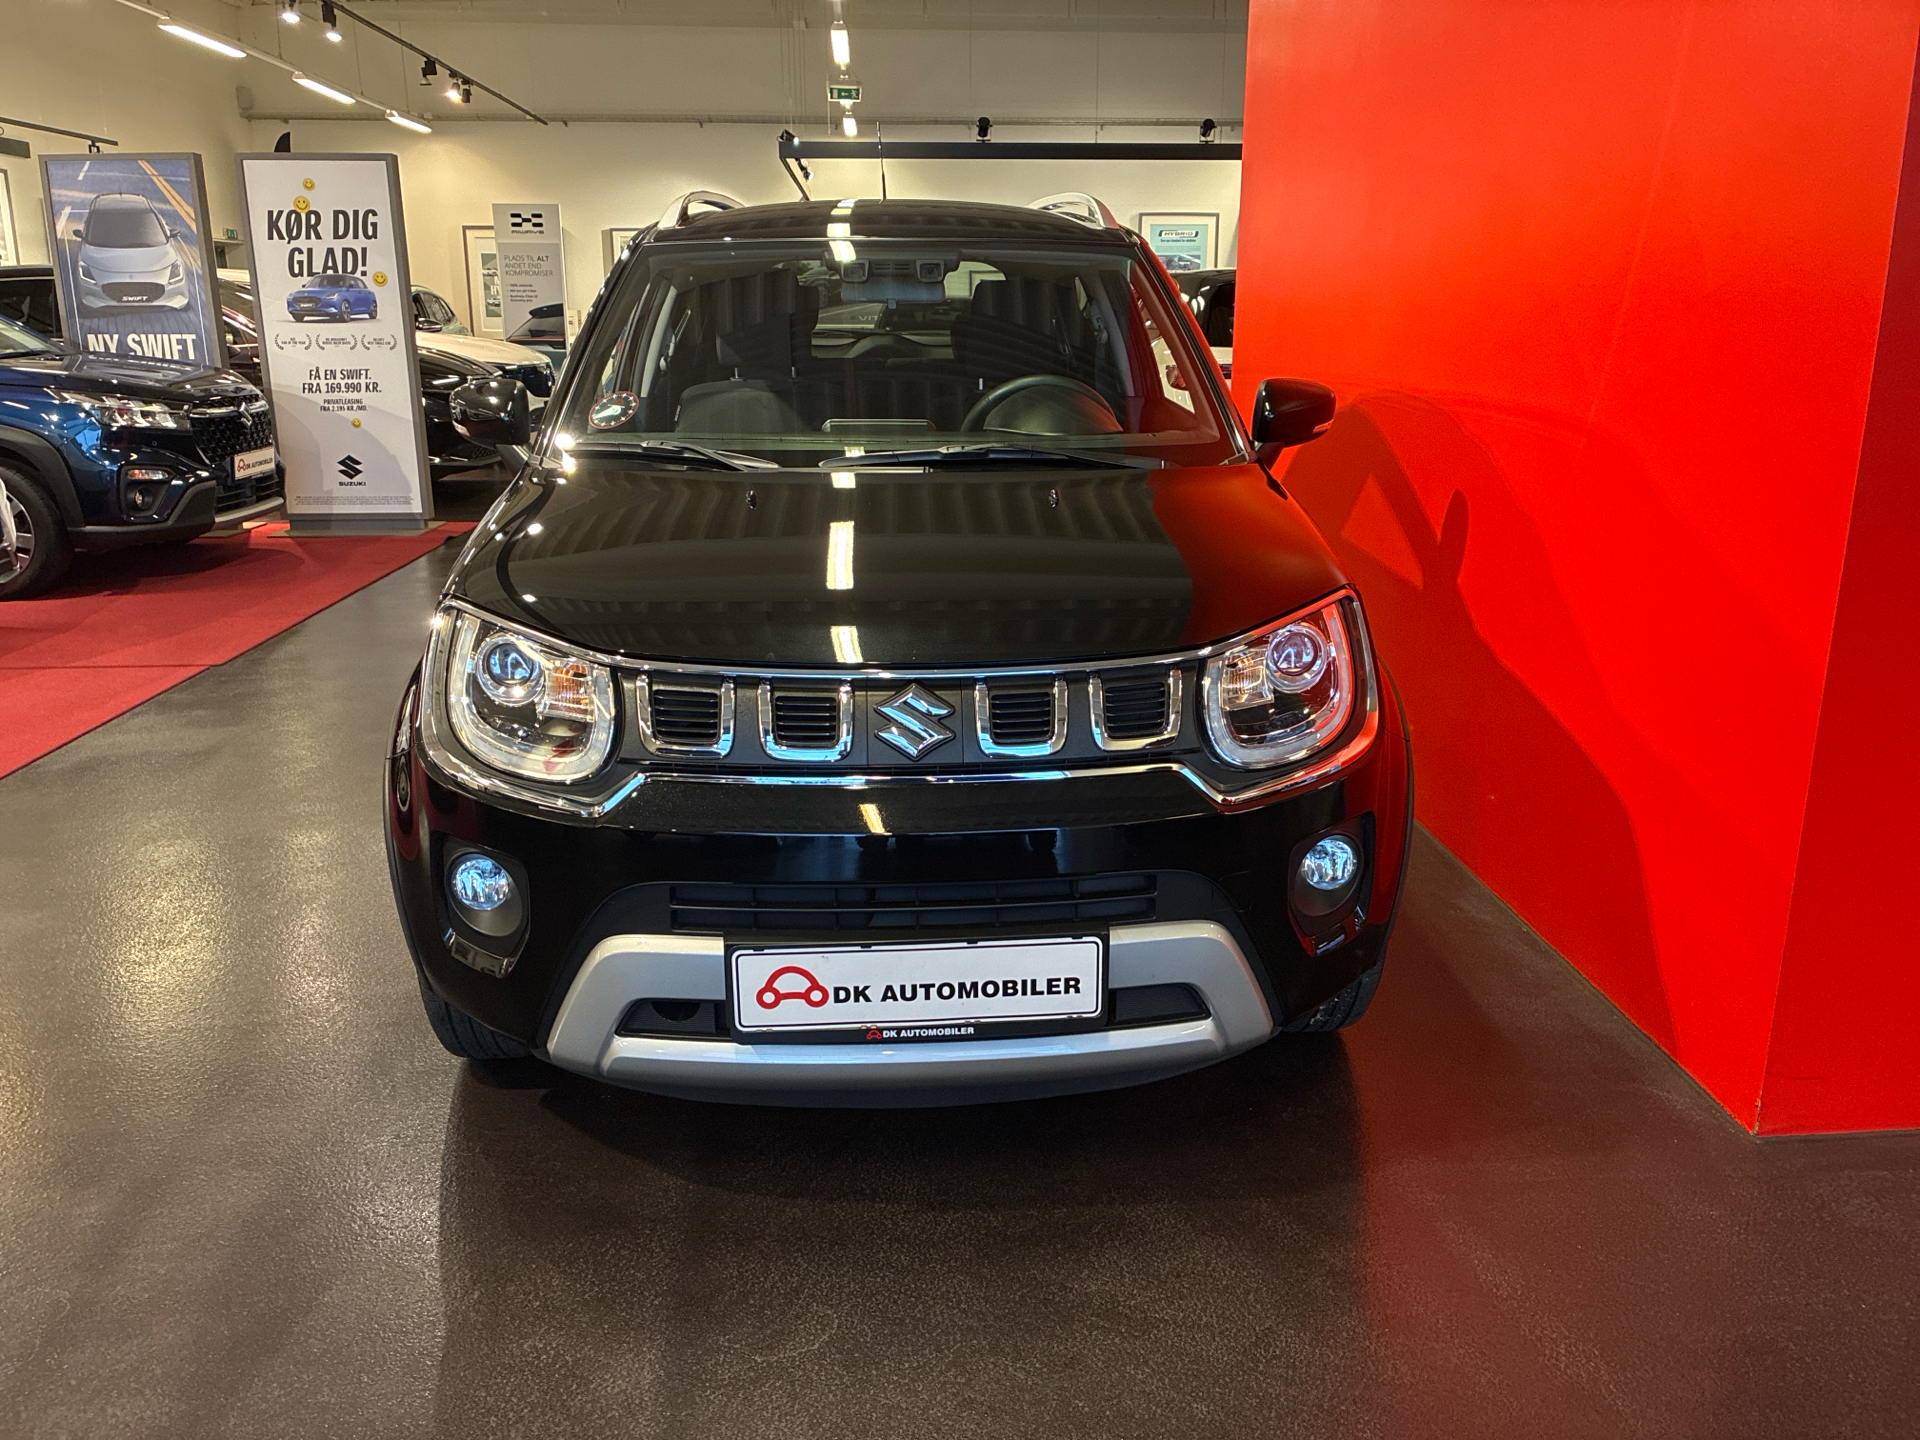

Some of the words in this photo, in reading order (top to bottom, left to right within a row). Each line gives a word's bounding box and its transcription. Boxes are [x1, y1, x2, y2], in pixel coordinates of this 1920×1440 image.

[267, 209, 322, 244] KØR
[332, 208, 378, 240] DIG
[288, 247, 368, 278] GLAD!
[87, 333, 119, 354] NY
[127, 333, 196, 360] SWIFT
[309, 366, 321, 381] FÅ
[324, 369, 337, 381] EN
[340, 368, 372, 380] SWIFT.
[302, 382, 322, 394] FRA
[325, 382, 361, 394] 169.990
[365, 381, 382, 393] KR.
[833, 985, 871, 1004] DK
[880, 977, 1082, 1003] AUTOMOBILER
[882, 1029, 898, 1039] DK
[900, 1026, 975, 1037] AUTOMOBILER
